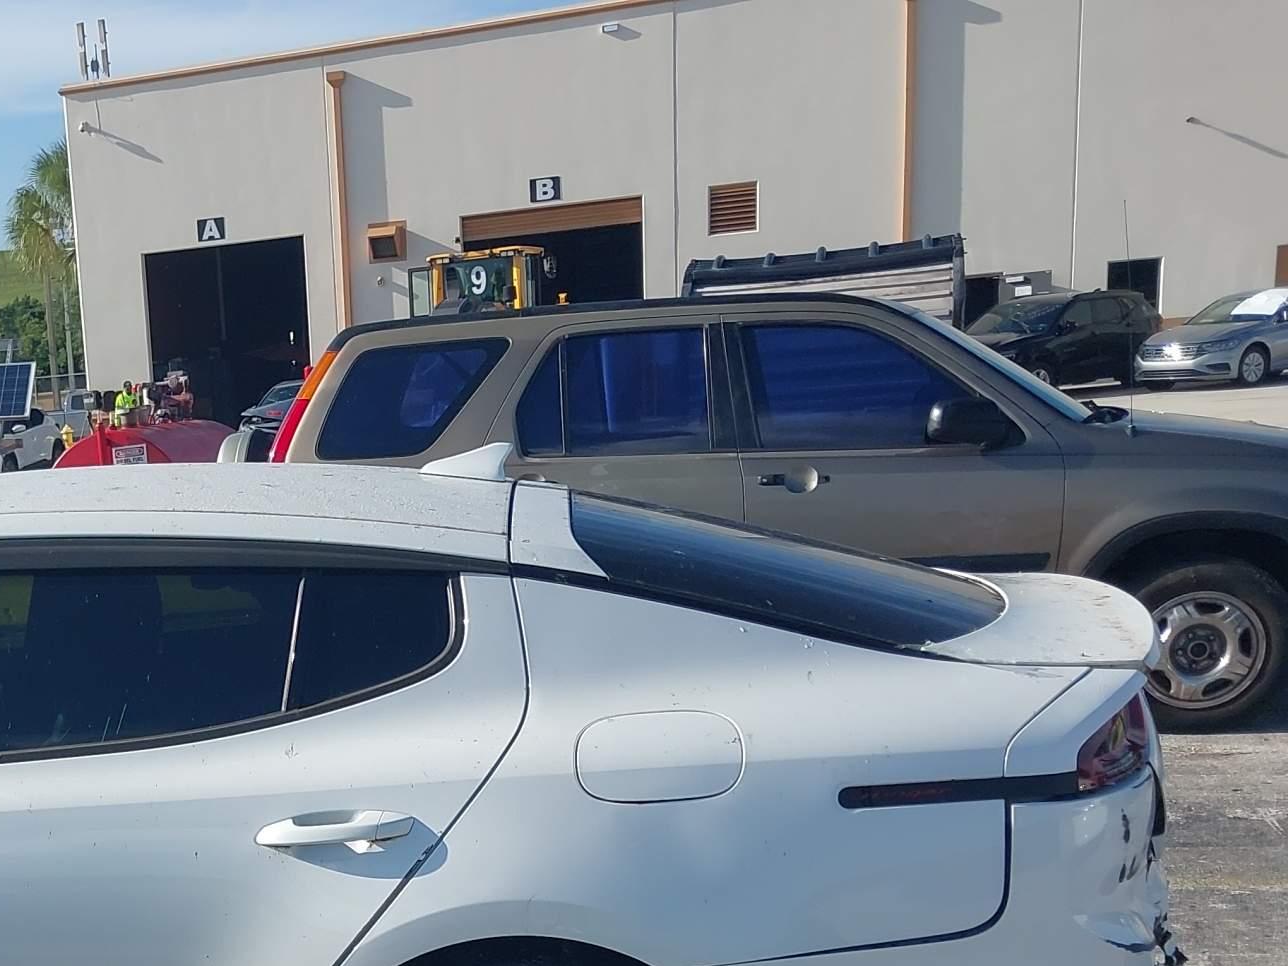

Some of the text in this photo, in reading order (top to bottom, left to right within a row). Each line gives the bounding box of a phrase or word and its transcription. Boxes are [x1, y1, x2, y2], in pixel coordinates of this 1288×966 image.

[536, 179, 555, 200] B
[202, 219, 221, 240] A
[471, 265, 487, 295] 9
